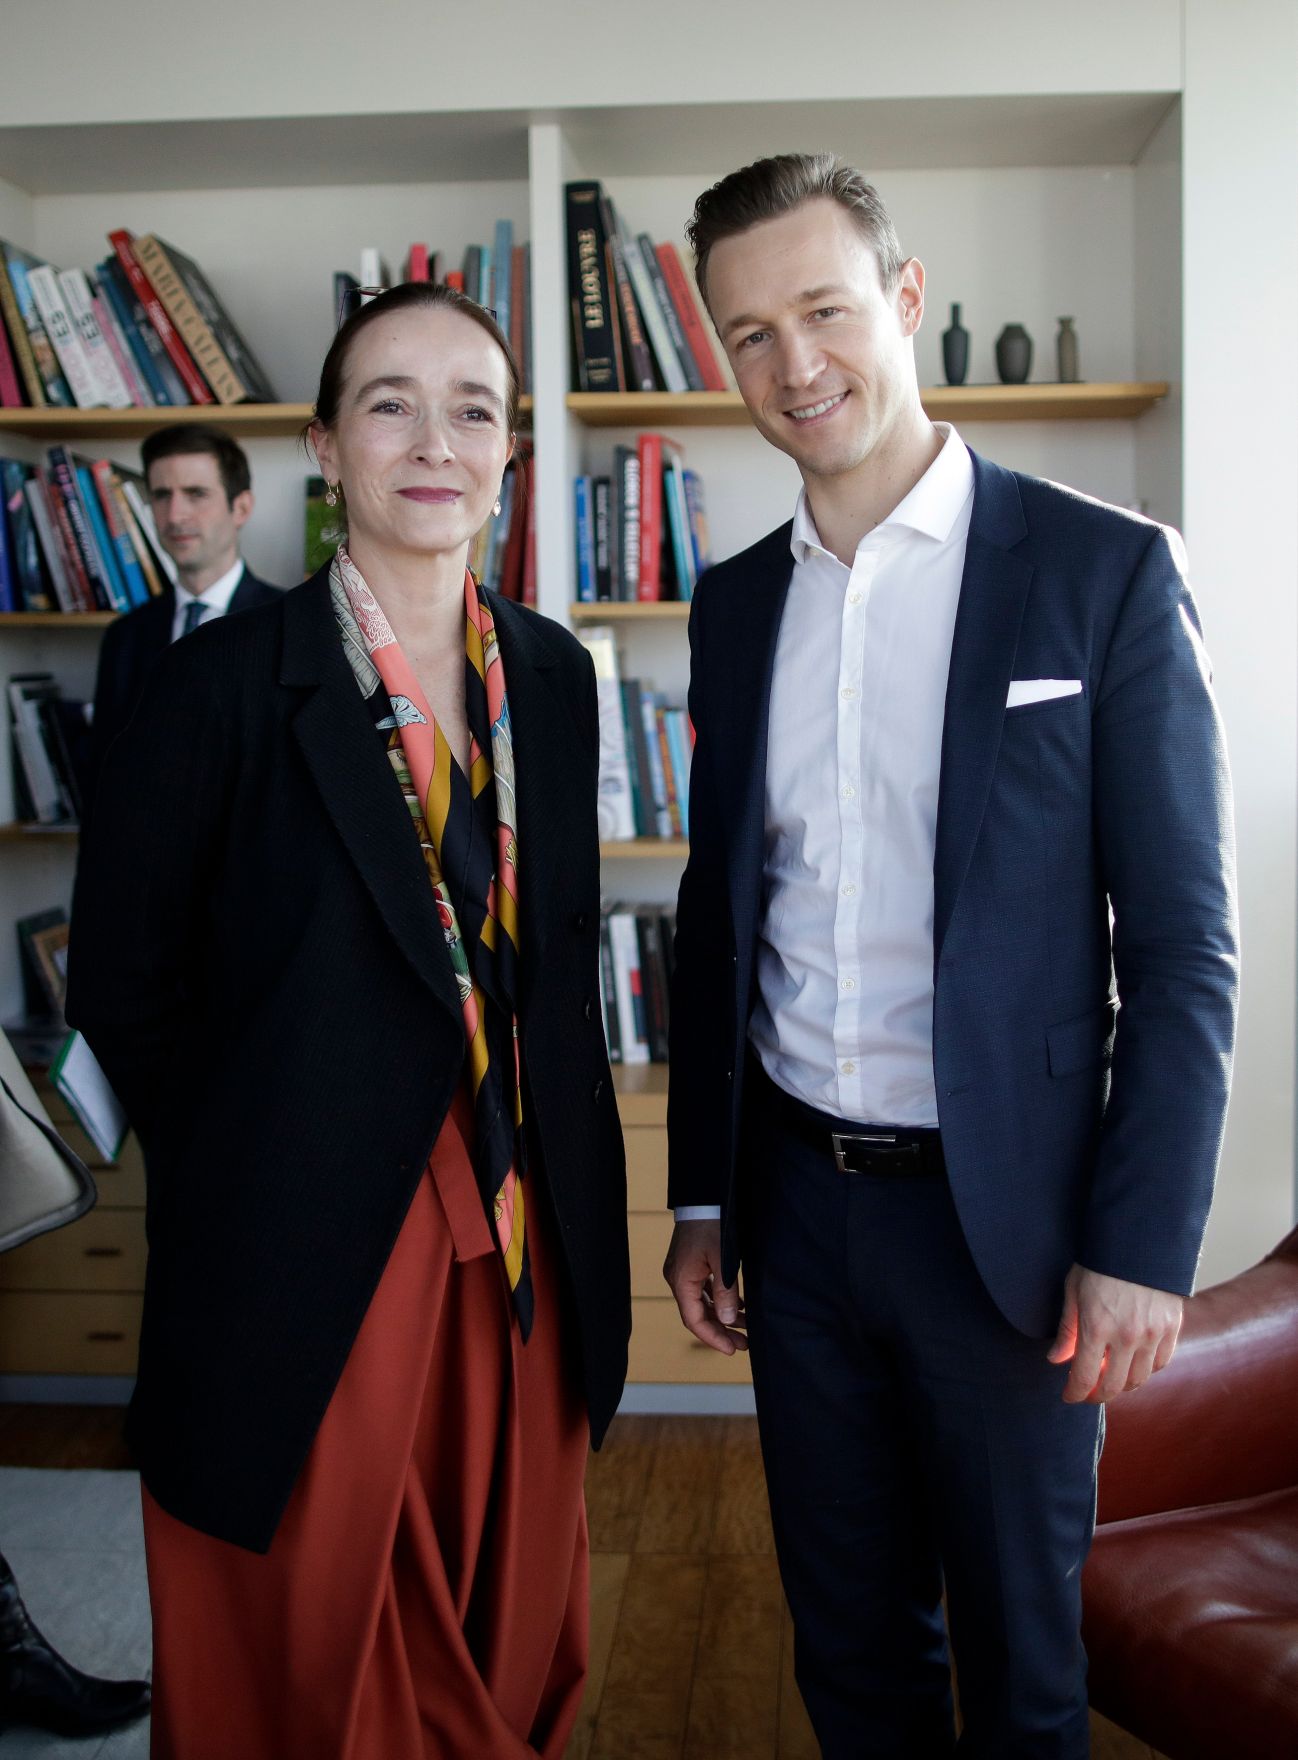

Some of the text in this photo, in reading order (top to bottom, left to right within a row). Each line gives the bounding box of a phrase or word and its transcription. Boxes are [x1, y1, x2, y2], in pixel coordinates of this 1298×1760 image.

[577, 228, 602, 303] LOUVRE
[142, 240, 187, 313] MARIA
[182, 313, 237, 397] CALLAS
[584, 303, 604, 328] LE
